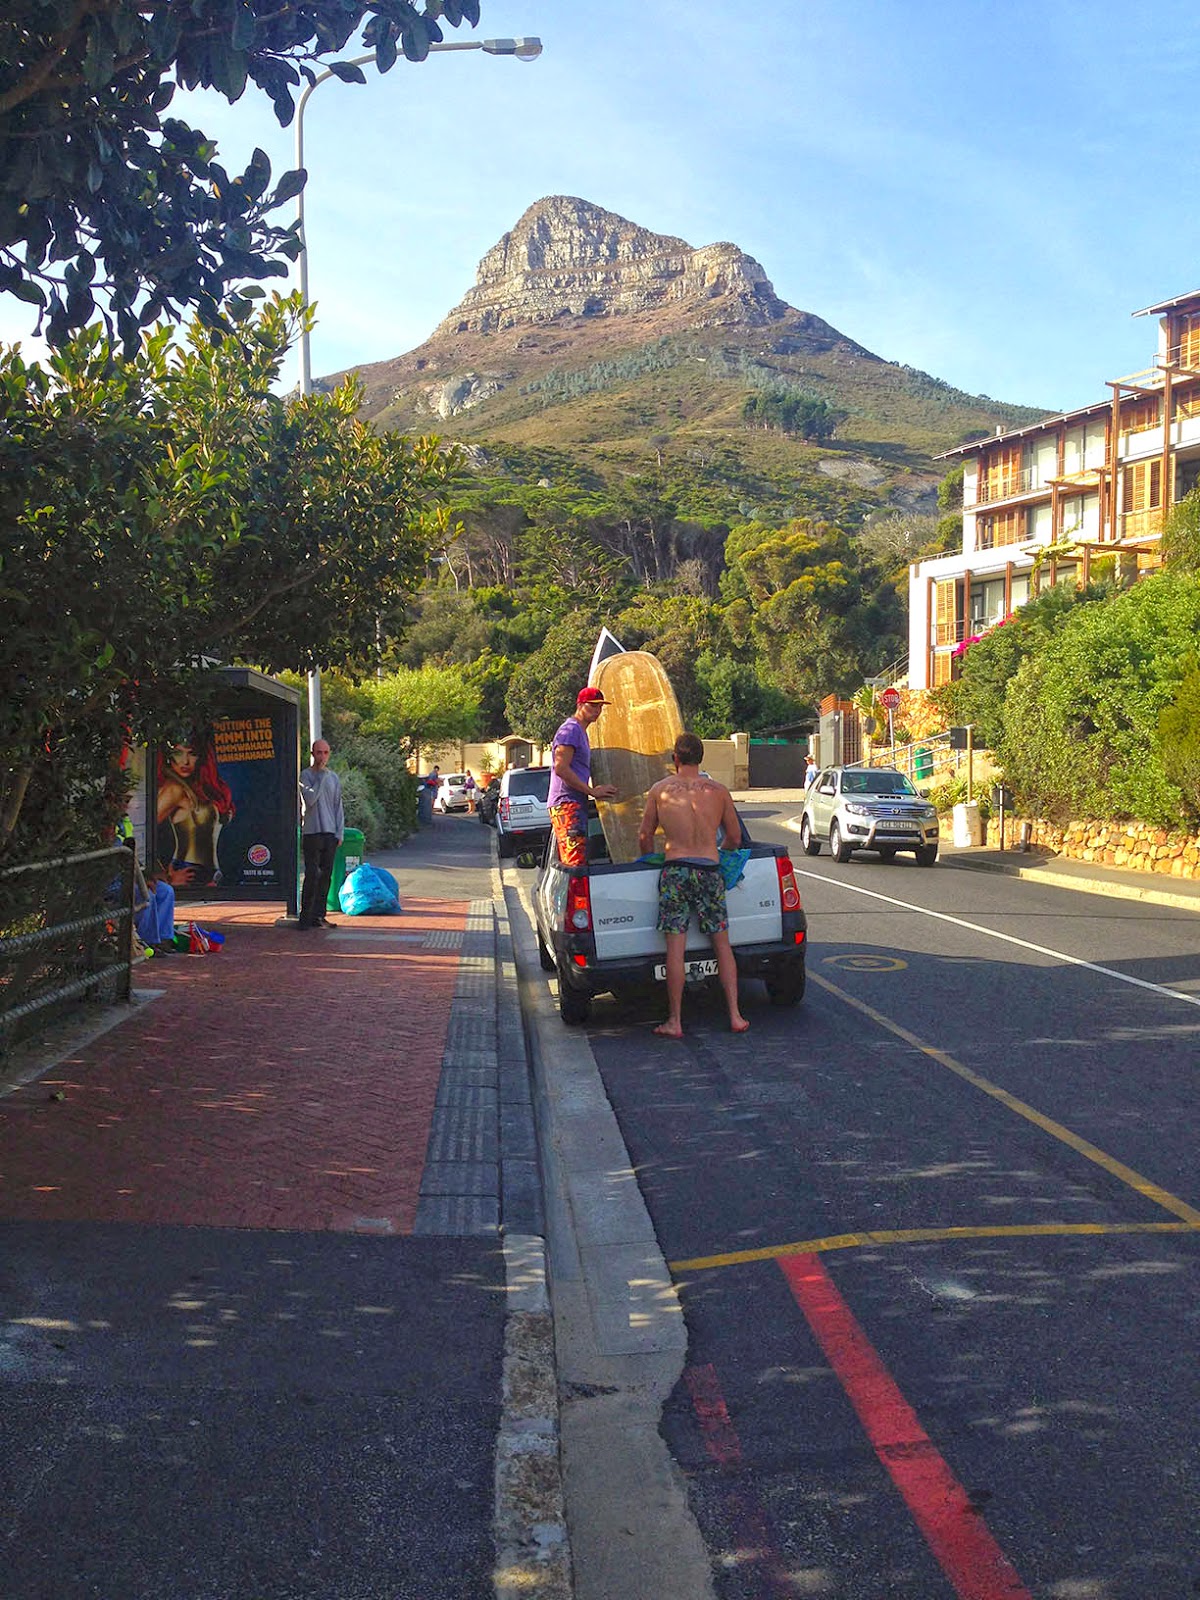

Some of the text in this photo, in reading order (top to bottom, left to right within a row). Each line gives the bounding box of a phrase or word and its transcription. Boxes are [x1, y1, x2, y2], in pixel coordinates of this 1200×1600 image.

[884, 694, 899, 703] STOP
[255, 718, 272, 729] THE
[214, 729, 273, 744] MMM INTO
